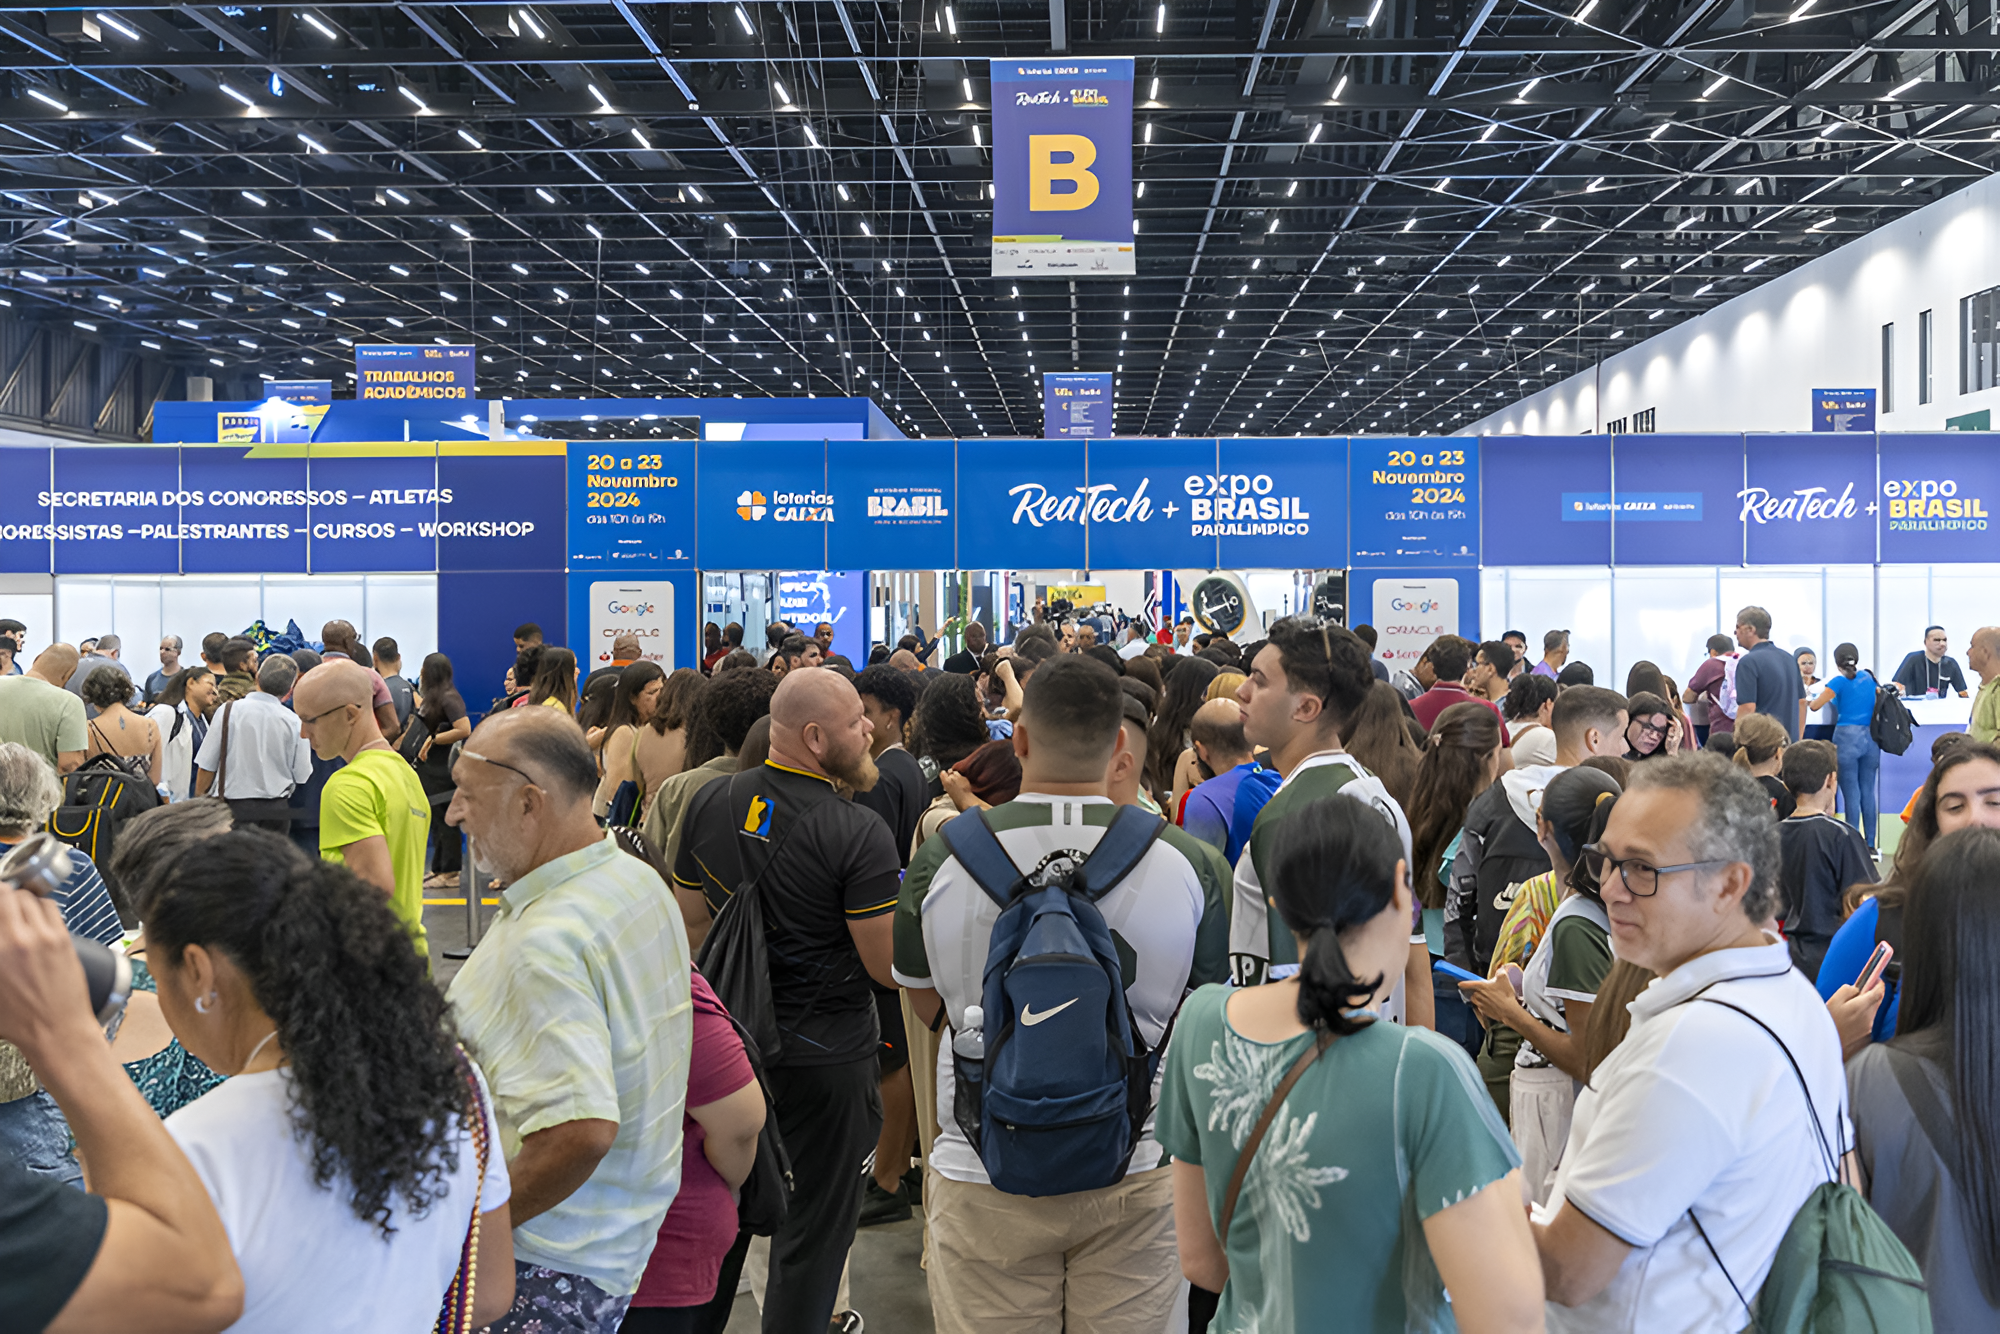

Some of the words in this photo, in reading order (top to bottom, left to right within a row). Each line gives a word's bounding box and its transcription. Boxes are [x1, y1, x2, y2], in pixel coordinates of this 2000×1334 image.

[1029, 134, 1100, 212] B
[364, 370, 455, 383] TRABALHOS
[587, 454, 615, 470] 20
[620, 458, 632, 470] a
[637, 454, 663, 470] 23
[1387, 450, 1416, 466] 20
[1421, 454, 1434, 466] a
[1439, 450, 1465, 465] 23
[587, 472, 678, 488] Novembro
[1372, 470, 1465, 484] Novembro
[1184, 475, 1273, 500] expo
[1411, 488, 1466, 504] 2024
[1883, 480, 1957, 500] expo
[38, 491, 158, 507] SECRETARIA
[162, 490, 204, 506] DOS
[208, 489, 348, 506] CONGRESSOS
[369, 488, 453, 504] ATLETAS
[587, 492, 640, 508] 2024
[773, 490, 834, 505] loterias
[867, 496, 948, 517] BRASIL
[1009, 477, 1154, 527] ReaTech
[1737, 482, 1859, 524] ReaTech
[773, 507, 835, 522] CAIXA
[1191, 496, 1310, 520] BRASIL
[1889, 499, 1988, 518] BRASIL
[313, 522, 396, 540] CURSOS
[418, 521, 534, 538] WORKSHOP
